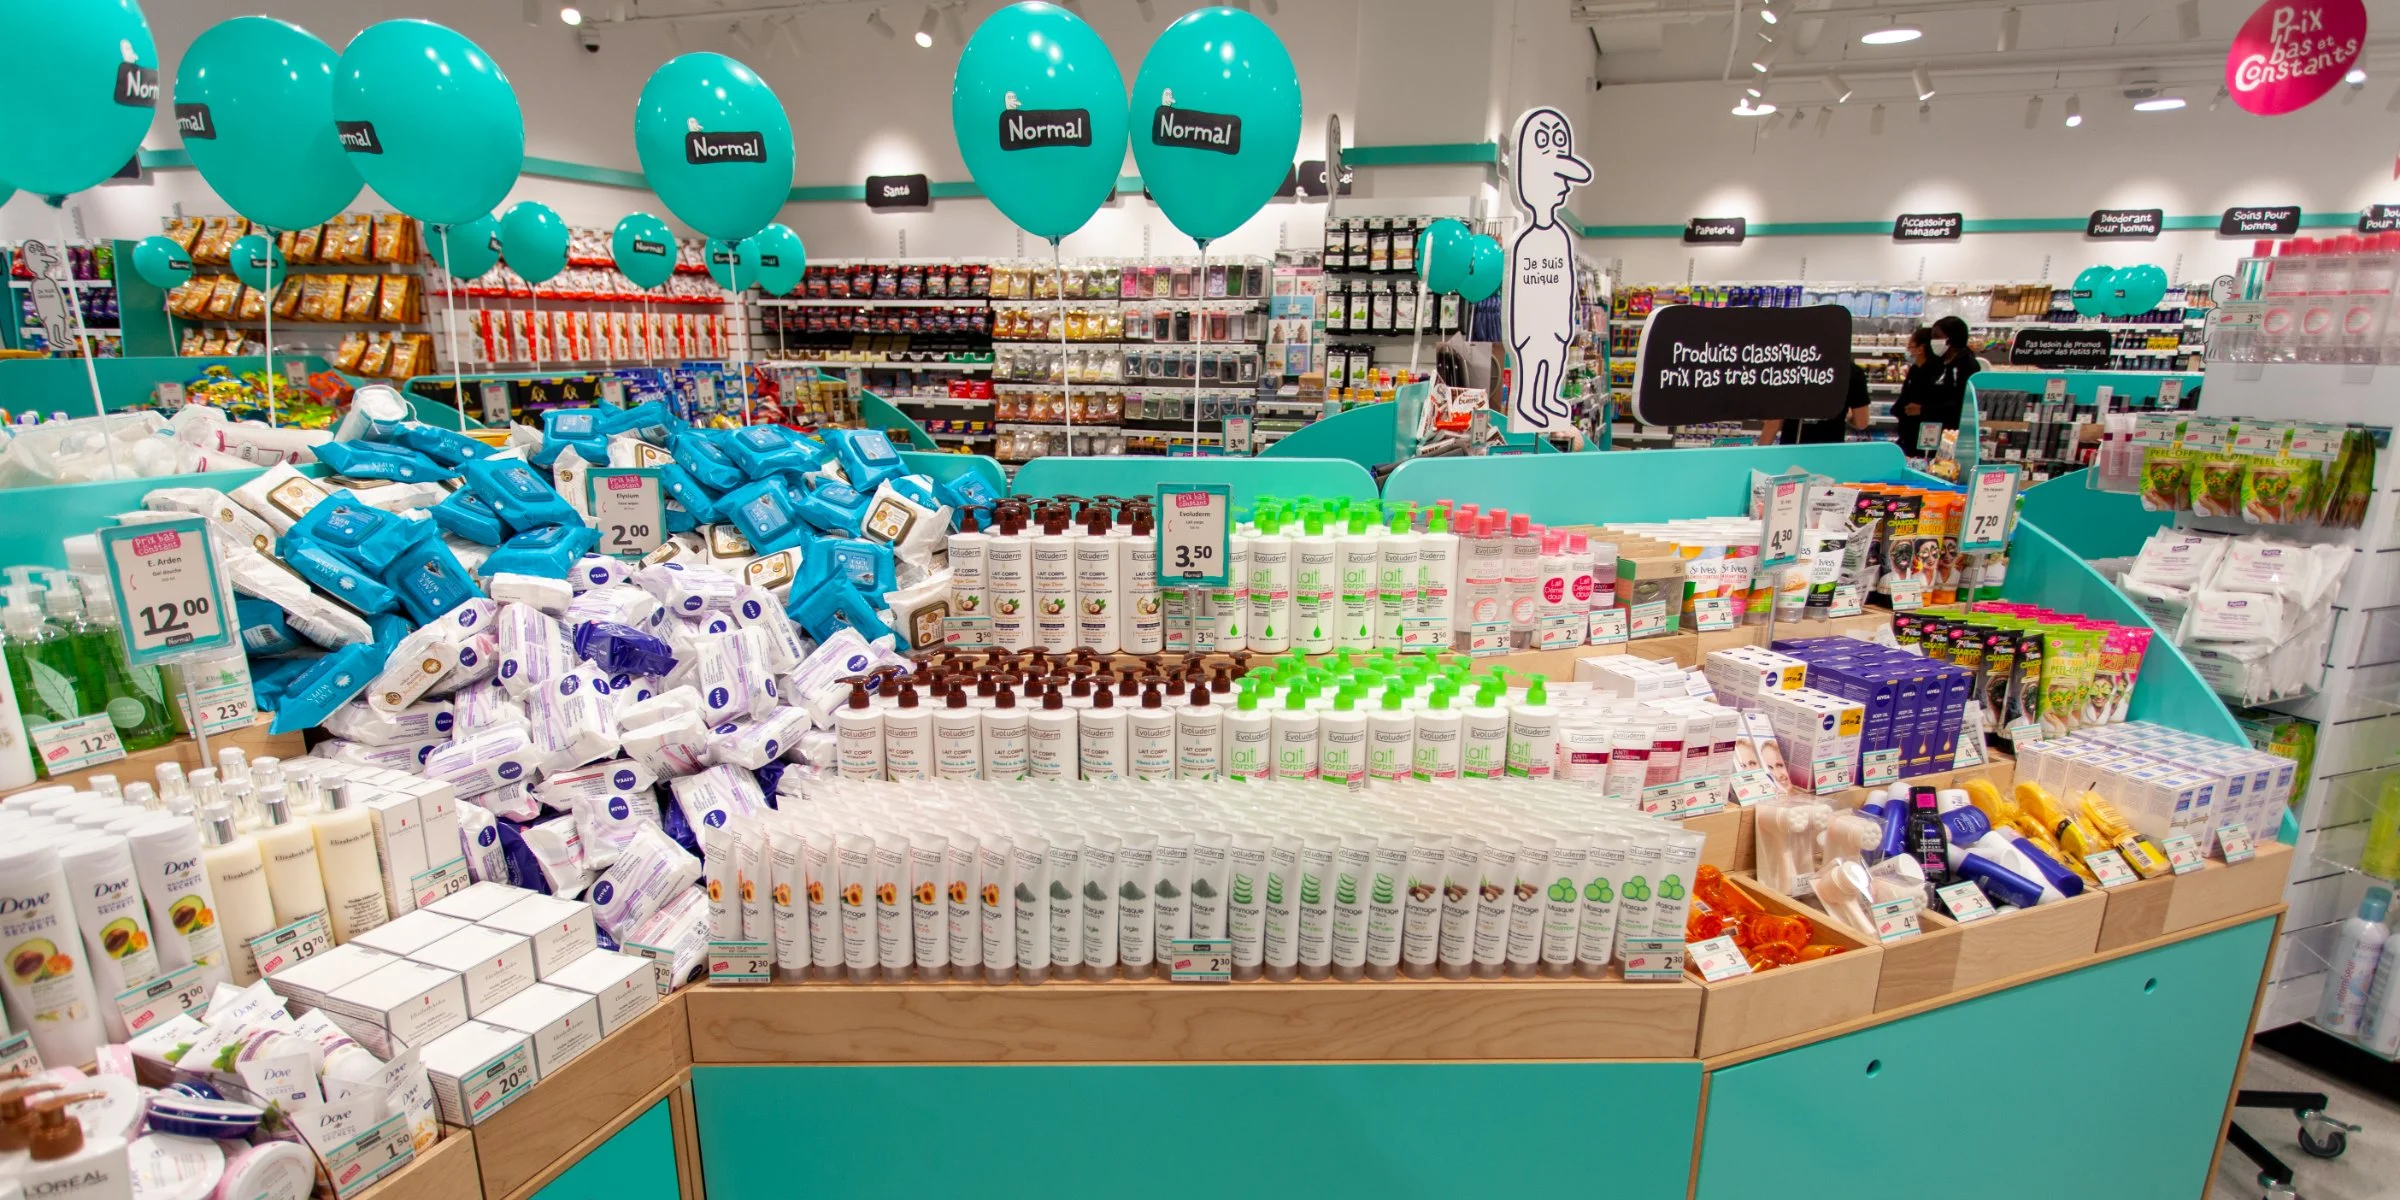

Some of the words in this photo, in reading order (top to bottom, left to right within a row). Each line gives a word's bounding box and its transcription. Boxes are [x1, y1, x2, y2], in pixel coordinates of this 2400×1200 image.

[2270, 6, 2323, 43] Prix
[2269, 35, 2313, 65] bas
[2317, 35, 2335, 49] et
[2235, 38, 2358, 92] Constants
[1008, 116, 1083, 143] Normal
[1160, 112, 1232, 146] Normal
[692, 138, 759, 158] Normal
[2233, 210, 2261, 222] Soins
[2120, 222, 2155, 233] homme
[2240, 220, 2278, 232] homme
[1523, 257, 1538, 271] Je
[1542, 257, 1563, 270] suis
[1523, 271, 1560, 286] unique
[1673, 342, 1738, 364] Produits
[1725, 365, 1756, 385] très
[1974, 515, 1998, 535] 7.20
[135, 534, 156, 549] Prix
[158, 531, 175, 545] bas
[612, 525, 649, 545] 2.00
[147, 558, 156, 567] E.
[157, 556, 182, 566] Arden
[1175, 545, 1212, 568] 3.50
[1700, 565, 1717, 574] Ives
[1730, 565, 1747, 574] Ives
[140, 598, 209, 636] 12.00
[168, 636, 191, 645] Normal
[1231, 747, 1256, 763] lait
[1280, 747, 1304, 762] lait
[1323, 747, 1347, 763] lait
[1370, 747, 1395, 763] lait
[1464, 744, 1490, 760] lait
[611, 804, 627, 812] NIVEA
[330, 835, 360, 846] Elizabeth
[275, 850, 305, 862] Elizabeth
[164, 856, 197, 876] Dove
[223, 870, 253, 882] Elizabeth
[94, 878, 130, 897] Dove
[596, 884, 611, 904] NIVEA
[264, 1067, 292, 1081] Dove
[320, 1110, 352, 1127] Dove
